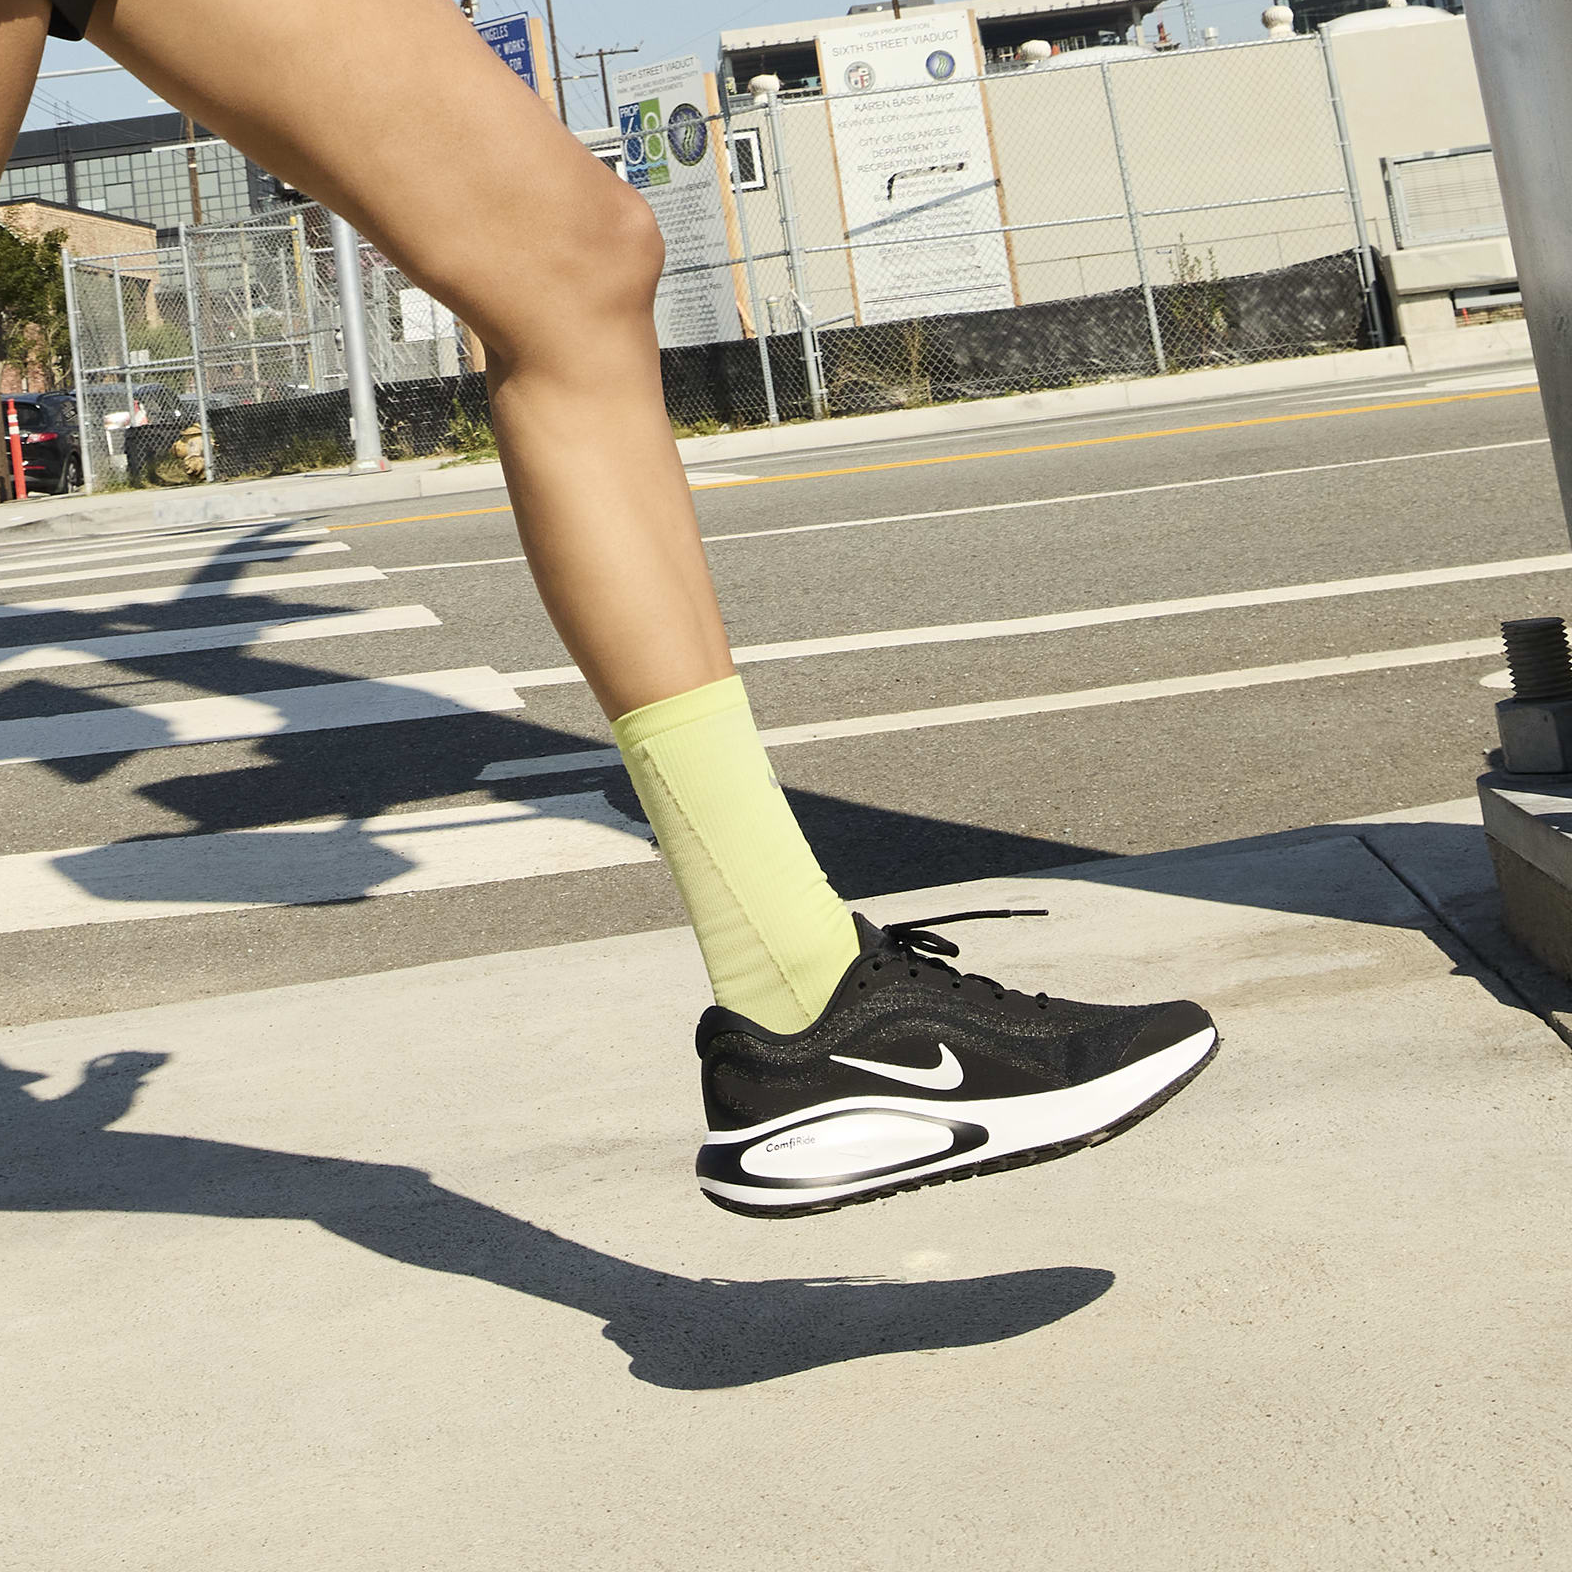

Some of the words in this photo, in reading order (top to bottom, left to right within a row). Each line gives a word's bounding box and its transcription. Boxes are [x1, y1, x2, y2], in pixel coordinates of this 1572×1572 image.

[832, 44, 865, 57] SIXTH
[866, 37, 908, 52] STREET
[912, 29, 959, 44] VIADUCT
[858, 30, 879, 39] YOUR
[638, 64, 664, 79] STREET
[620, 105, 639, 118] PROP
[854, 99, 891, 112] KAREN
[625, 112, 664, 165] 68
[859, 136, 881, 147] CITY
[882, 133, 895, 144] OF
[897, 130, 916, 142] LOS
[872, 141, 933, 158] DEPARTMENT
[937, 139, 949, 149] OF
[857, 157, 917, 173] RECREATION
[917, 154, 939, 165] AND
[940, 148, 972, 161] PARKS
[766, 1134, 816, 1153] ComfiRide
